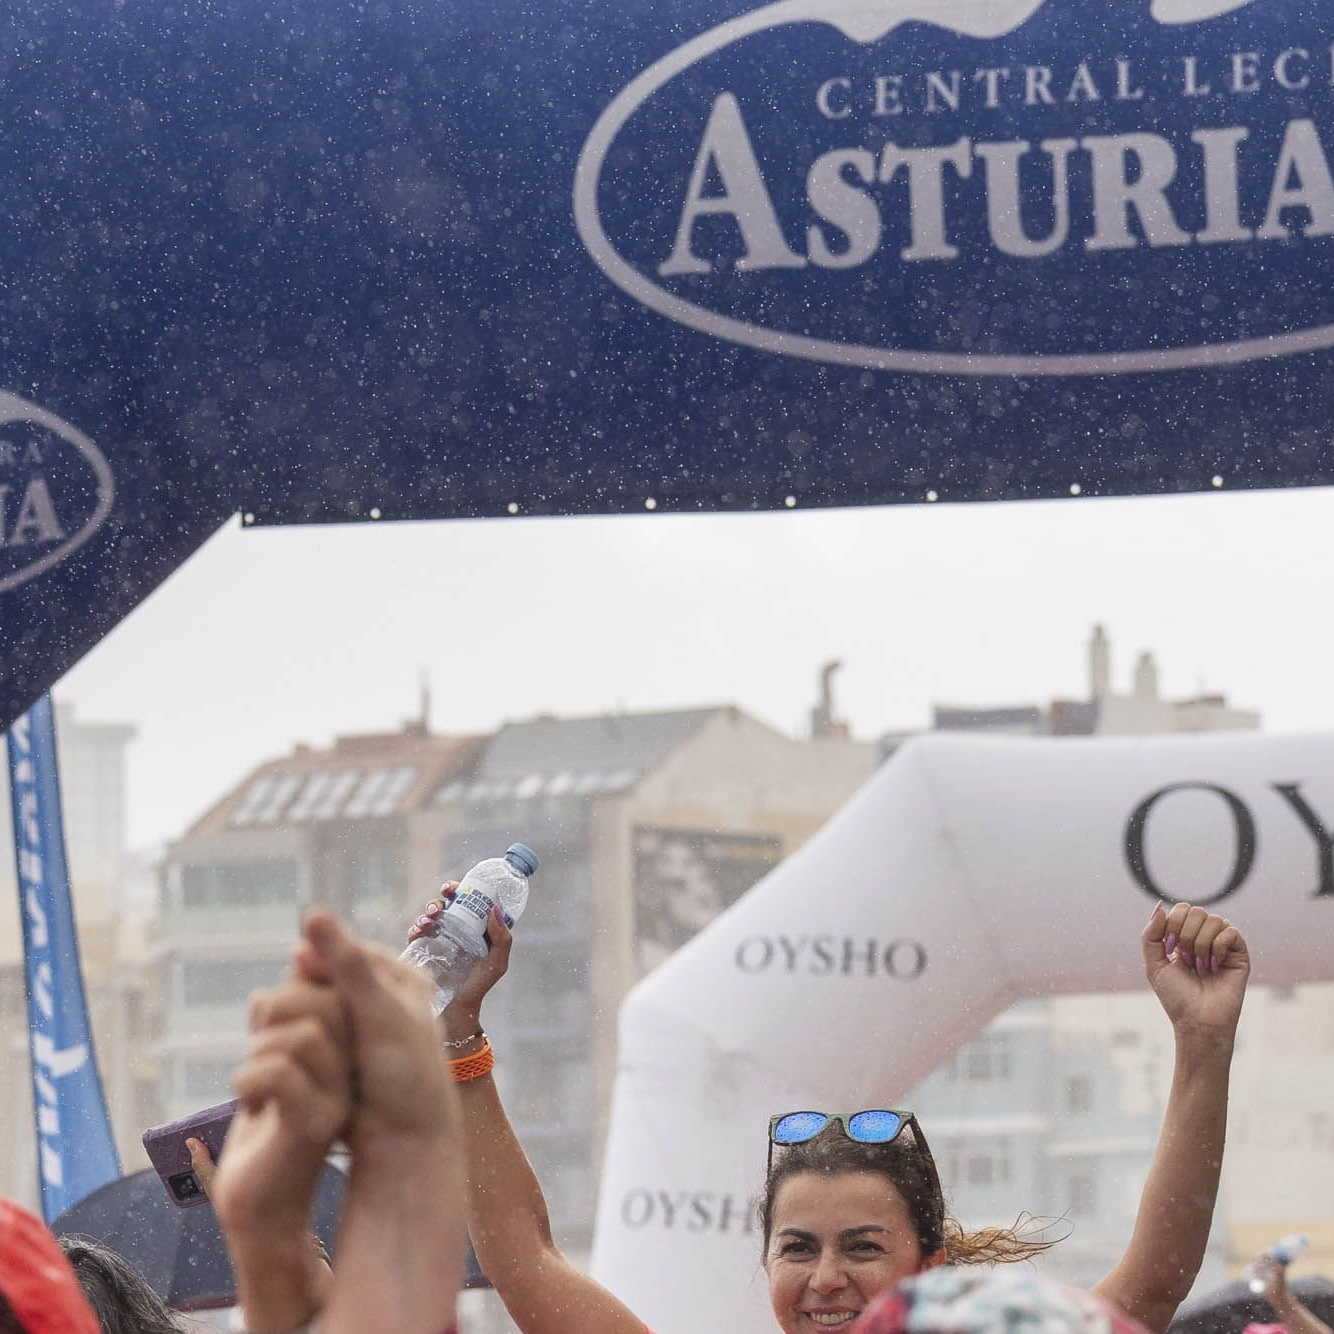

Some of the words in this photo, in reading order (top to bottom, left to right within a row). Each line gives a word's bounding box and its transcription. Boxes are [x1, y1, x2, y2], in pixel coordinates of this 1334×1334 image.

[815, 59, 1145, 121] CENTRAL
[733, 933, 928, 981] OYSHO
[619, 1187, 760, 1236] OYSH
